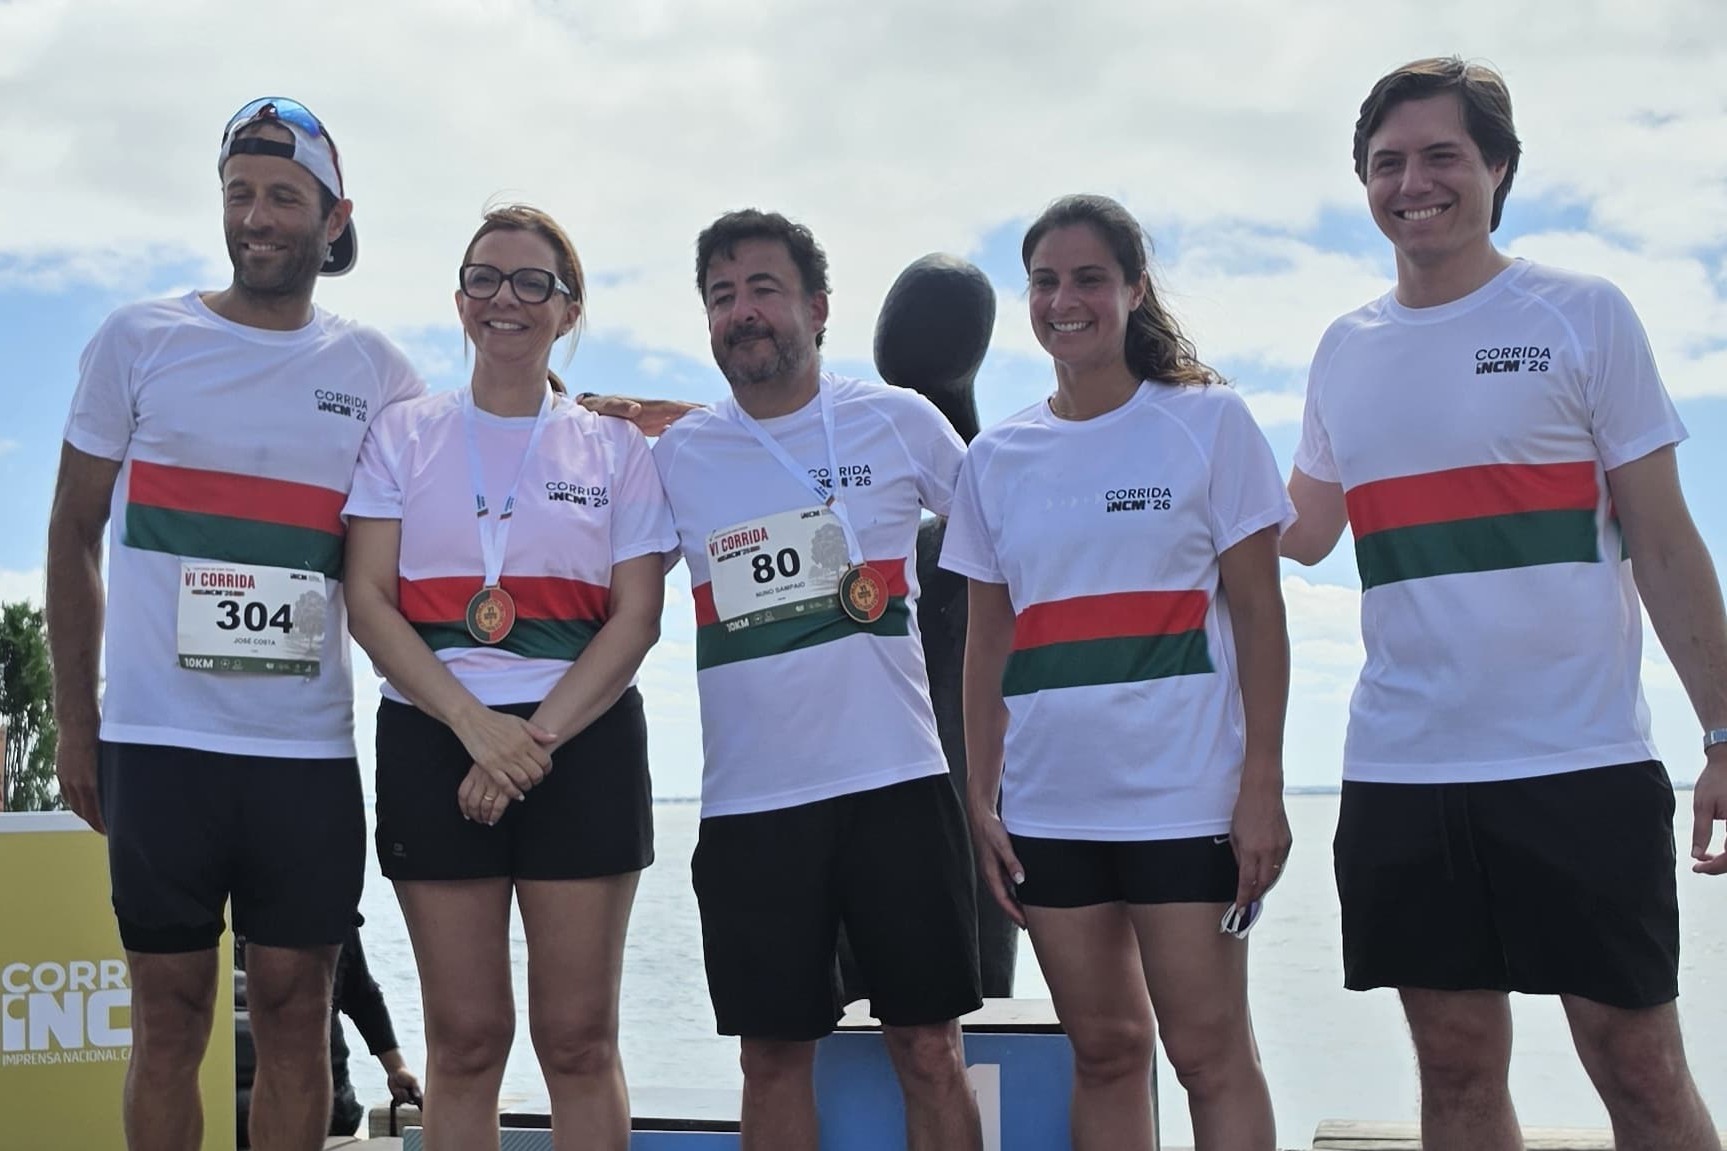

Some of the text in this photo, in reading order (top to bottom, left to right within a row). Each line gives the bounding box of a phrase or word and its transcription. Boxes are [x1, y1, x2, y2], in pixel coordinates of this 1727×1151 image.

[1475, 346, 1551, 361] CORRIDA
[314, 388, 368, 411] CORRIDA
[808, 464, 872, 478] CORIDA
[1105, 487, 1172, 501] CORRIDA
[709, 541, 719, 557] VI
[721, 527, 769, 552] CORRIDA
[751, 548, 801, 584] 80
[185, 572, 256, 589] VI CORRIDA
[216, 600, 293, 634] 304
[726, 618, 749, 632] 10KM
[253, 638, 276, 646] COSTA
[184, 658, 214, 669] 10KM
[2, 1053, 60, 1066] IMPRENSA
[63, 1049, 119, 1063] NACIONAL
